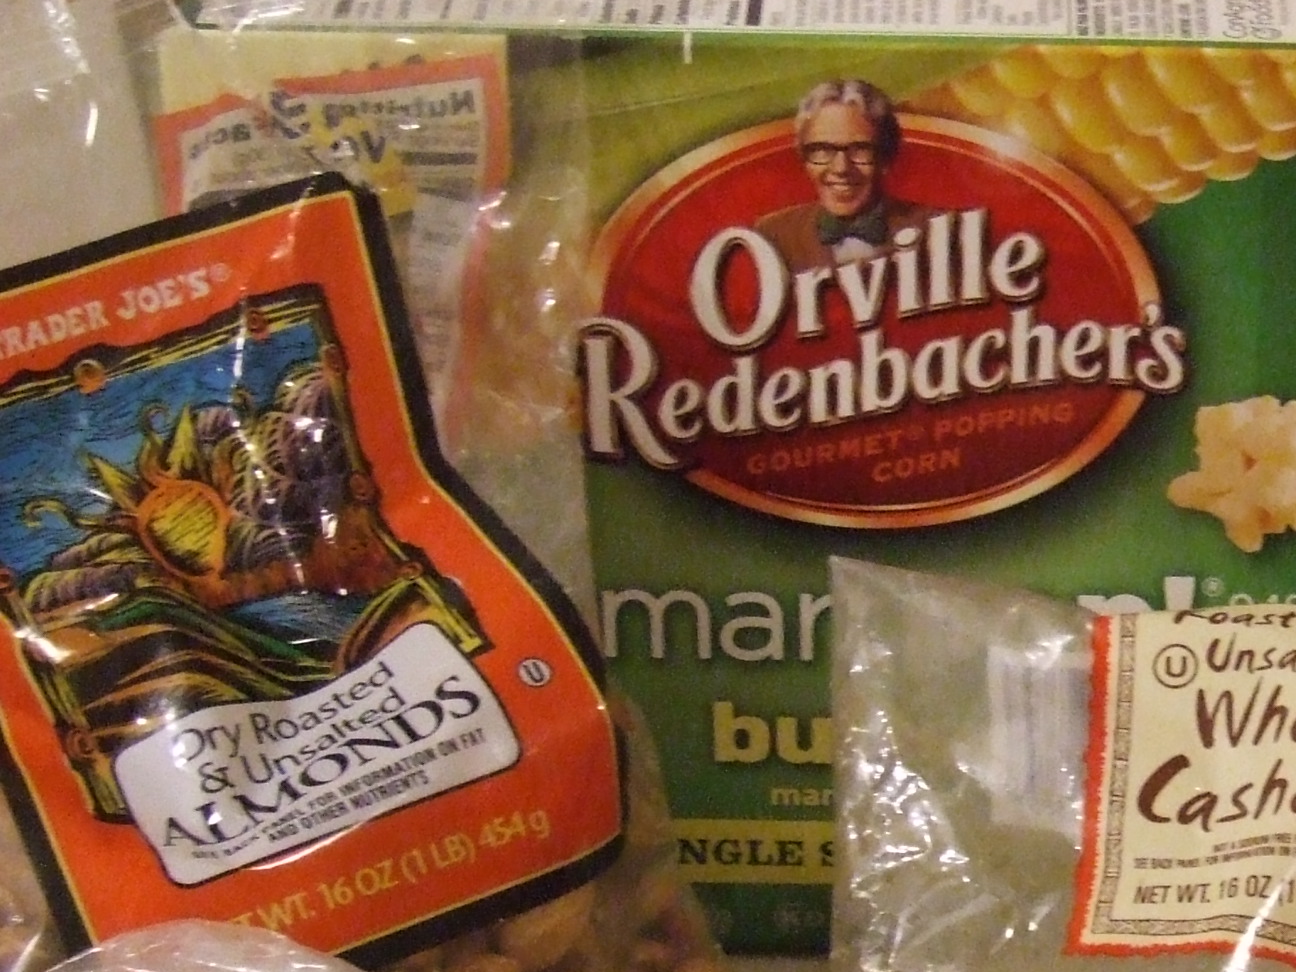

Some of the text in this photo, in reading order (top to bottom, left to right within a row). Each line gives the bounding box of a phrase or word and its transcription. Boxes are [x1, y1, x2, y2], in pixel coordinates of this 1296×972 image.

[0, 300, 111, 358] RADER
[690, 210, 1046, 351] Orville
[579, 302, 1186, 470] Redenbacher's
[934, 402, 1075, 440] POPPING
[870, 449, 961, 484] CORN
[163, 674, 482, 848] ALMONDS
[172, 661, 396, 769] Dry Roasted
[198, 686, 406, 794] & Unsalted
[256, 891, 317, 931] WT.
[316, 876, 355, 910] 16
[355, 857, 399, 896] OZ
[400, 848, 429, 884] (1
[429, 832, 476, 869] LB)
[1133, 884, 1171, 904] NET
[1177, 883, 1211, 904] WT.
[1217, 877, 1239, 900] 16
[1245, 874, 1273, 899] OZ
